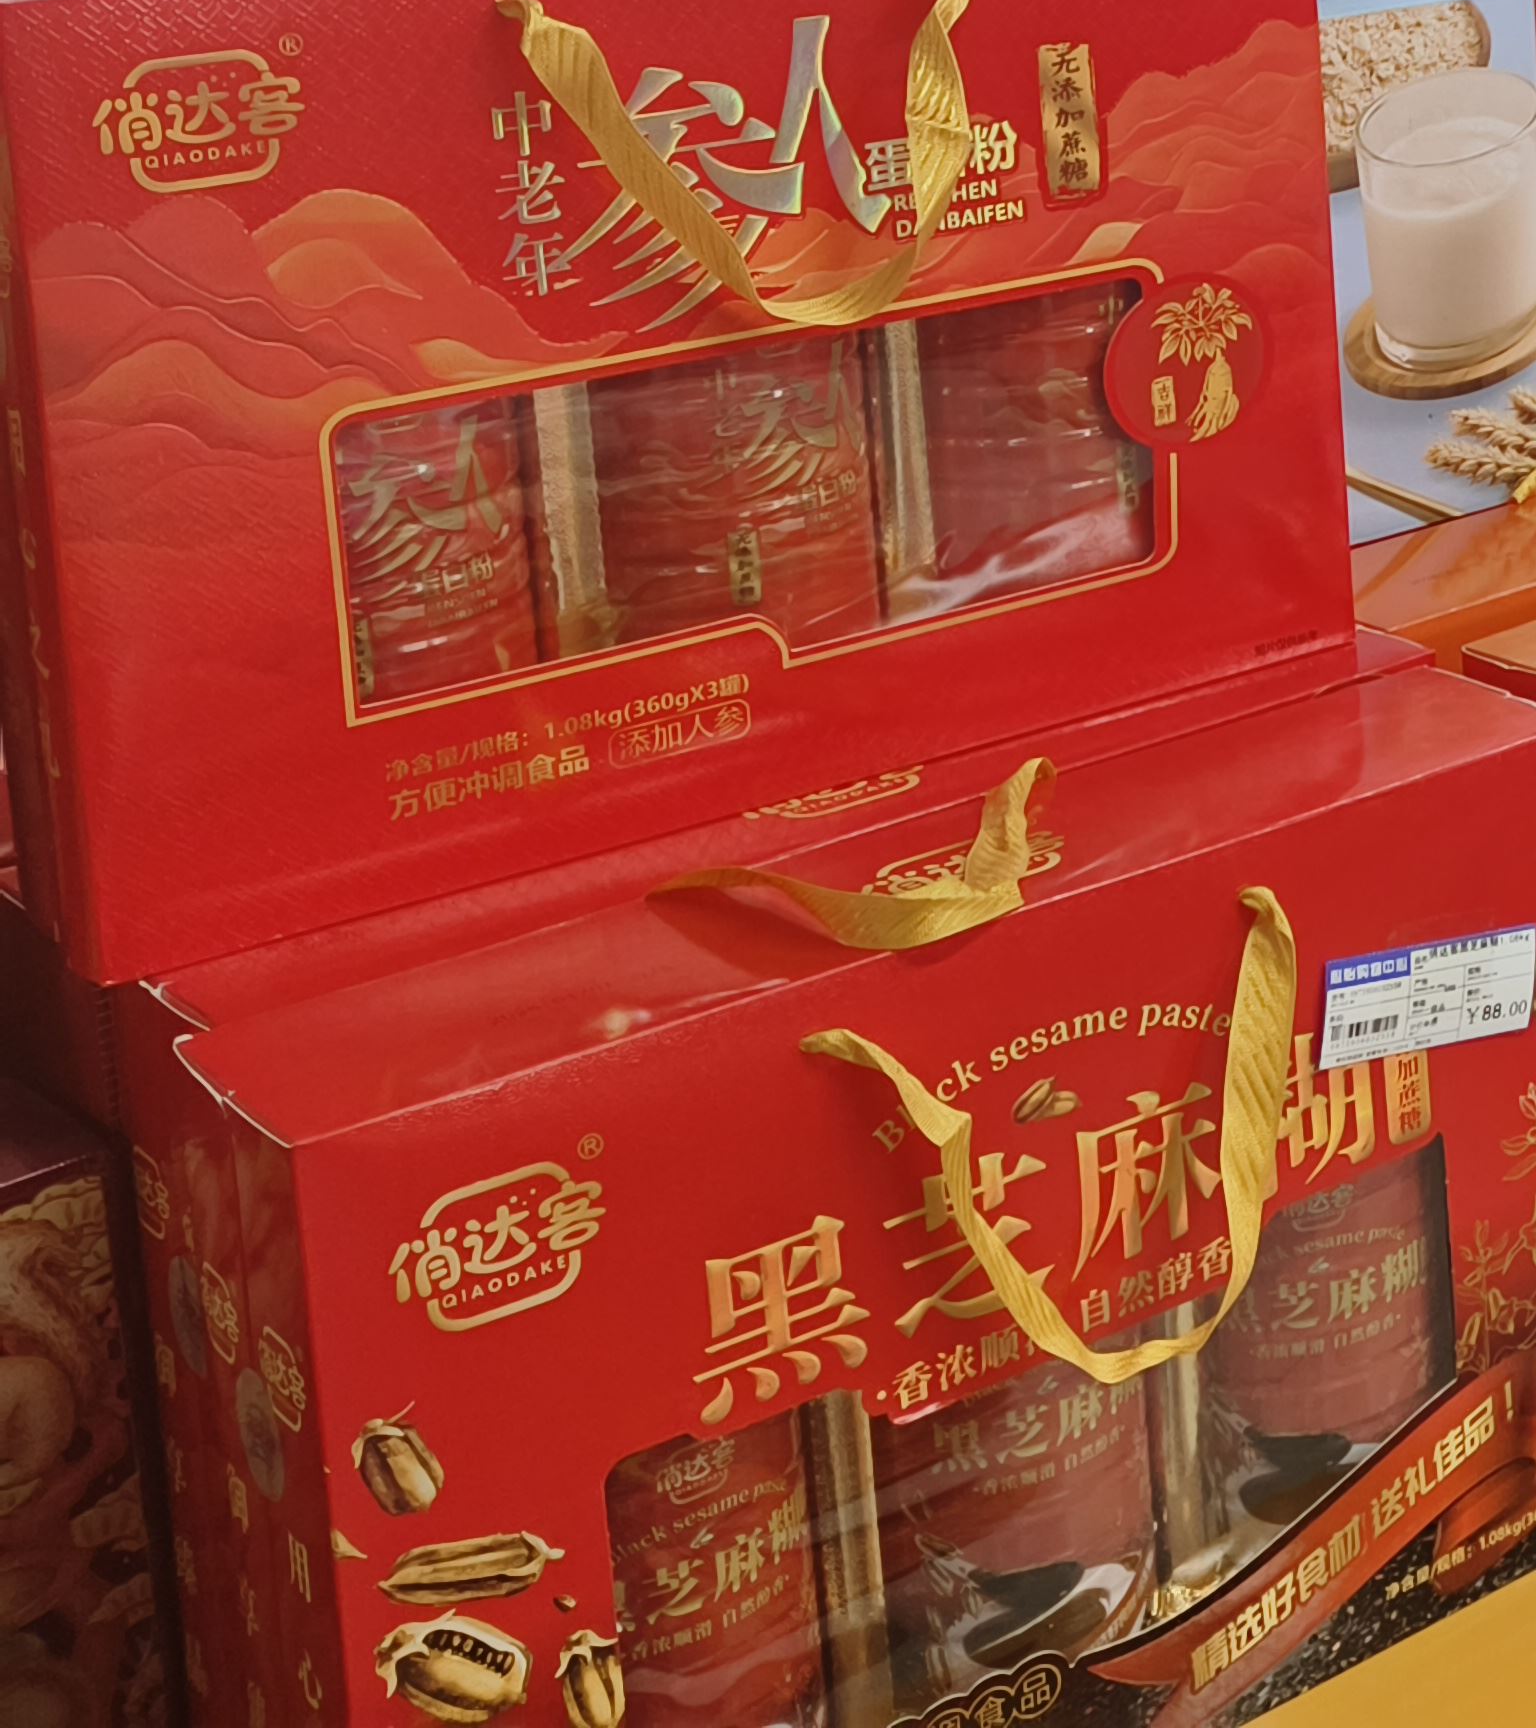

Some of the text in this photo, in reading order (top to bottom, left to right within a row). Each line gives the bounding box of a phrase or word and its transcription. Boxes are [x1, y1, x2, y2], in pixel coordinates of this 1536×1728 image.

[92, 71, 305, 155] 俏达客
[1050, 48, 1089, 182] 无添加蔗糖
[145, 139, 267, 170] QIAODAKE
[862, 119, 1018, 195] 蛋粉
[490, 91, 582, 297] 中老年
[894, 179, 998, 212] REHEN
[618, 704, 746, 761] 添加人参
[388, 745, 590, 821] 方便冲调食品
[990, 1002, 1129, 1072] sesame
[1394, 1051, 1427, 1140] 加蔗糖
[388, 1180, 607, 1303] 俏达客
[442, 1254, 567, 1309] QIAODAKE
[1081, 1235, 1233, 1333] 自然醇香
[672, 1488, 750, 1534] sesame
[1191, 1381, 1515, 1695] 精选好食材 送礼佳品！
